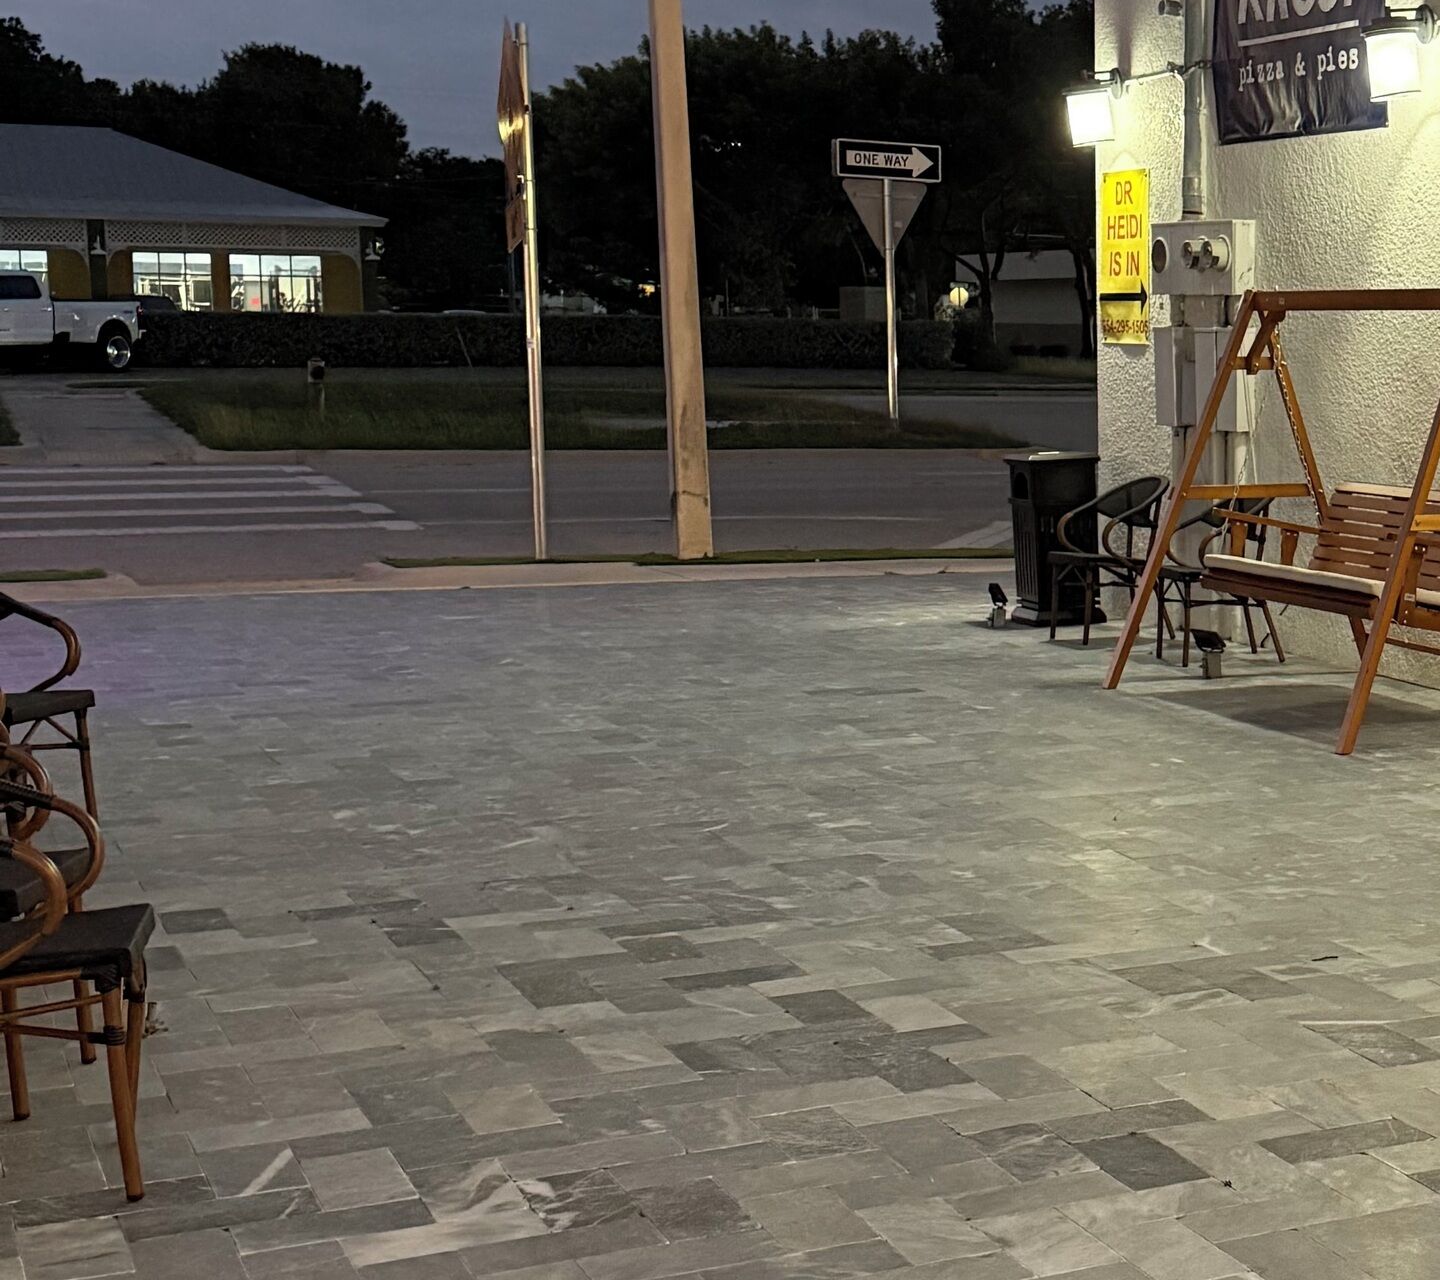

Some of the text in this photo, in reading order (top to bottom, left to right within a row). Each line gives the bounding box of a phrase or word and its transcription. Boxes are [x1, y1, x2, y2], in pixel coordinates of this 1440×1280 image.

[1239, 45, 1359, 92] pizza & pies
[854, 152, 909, 168] ONE WAY
[1115, 180, 1134, 206] DR
[1107, 213, 1142, 241] HEIDI
[1109, 250, 1140, 277] IS IN
